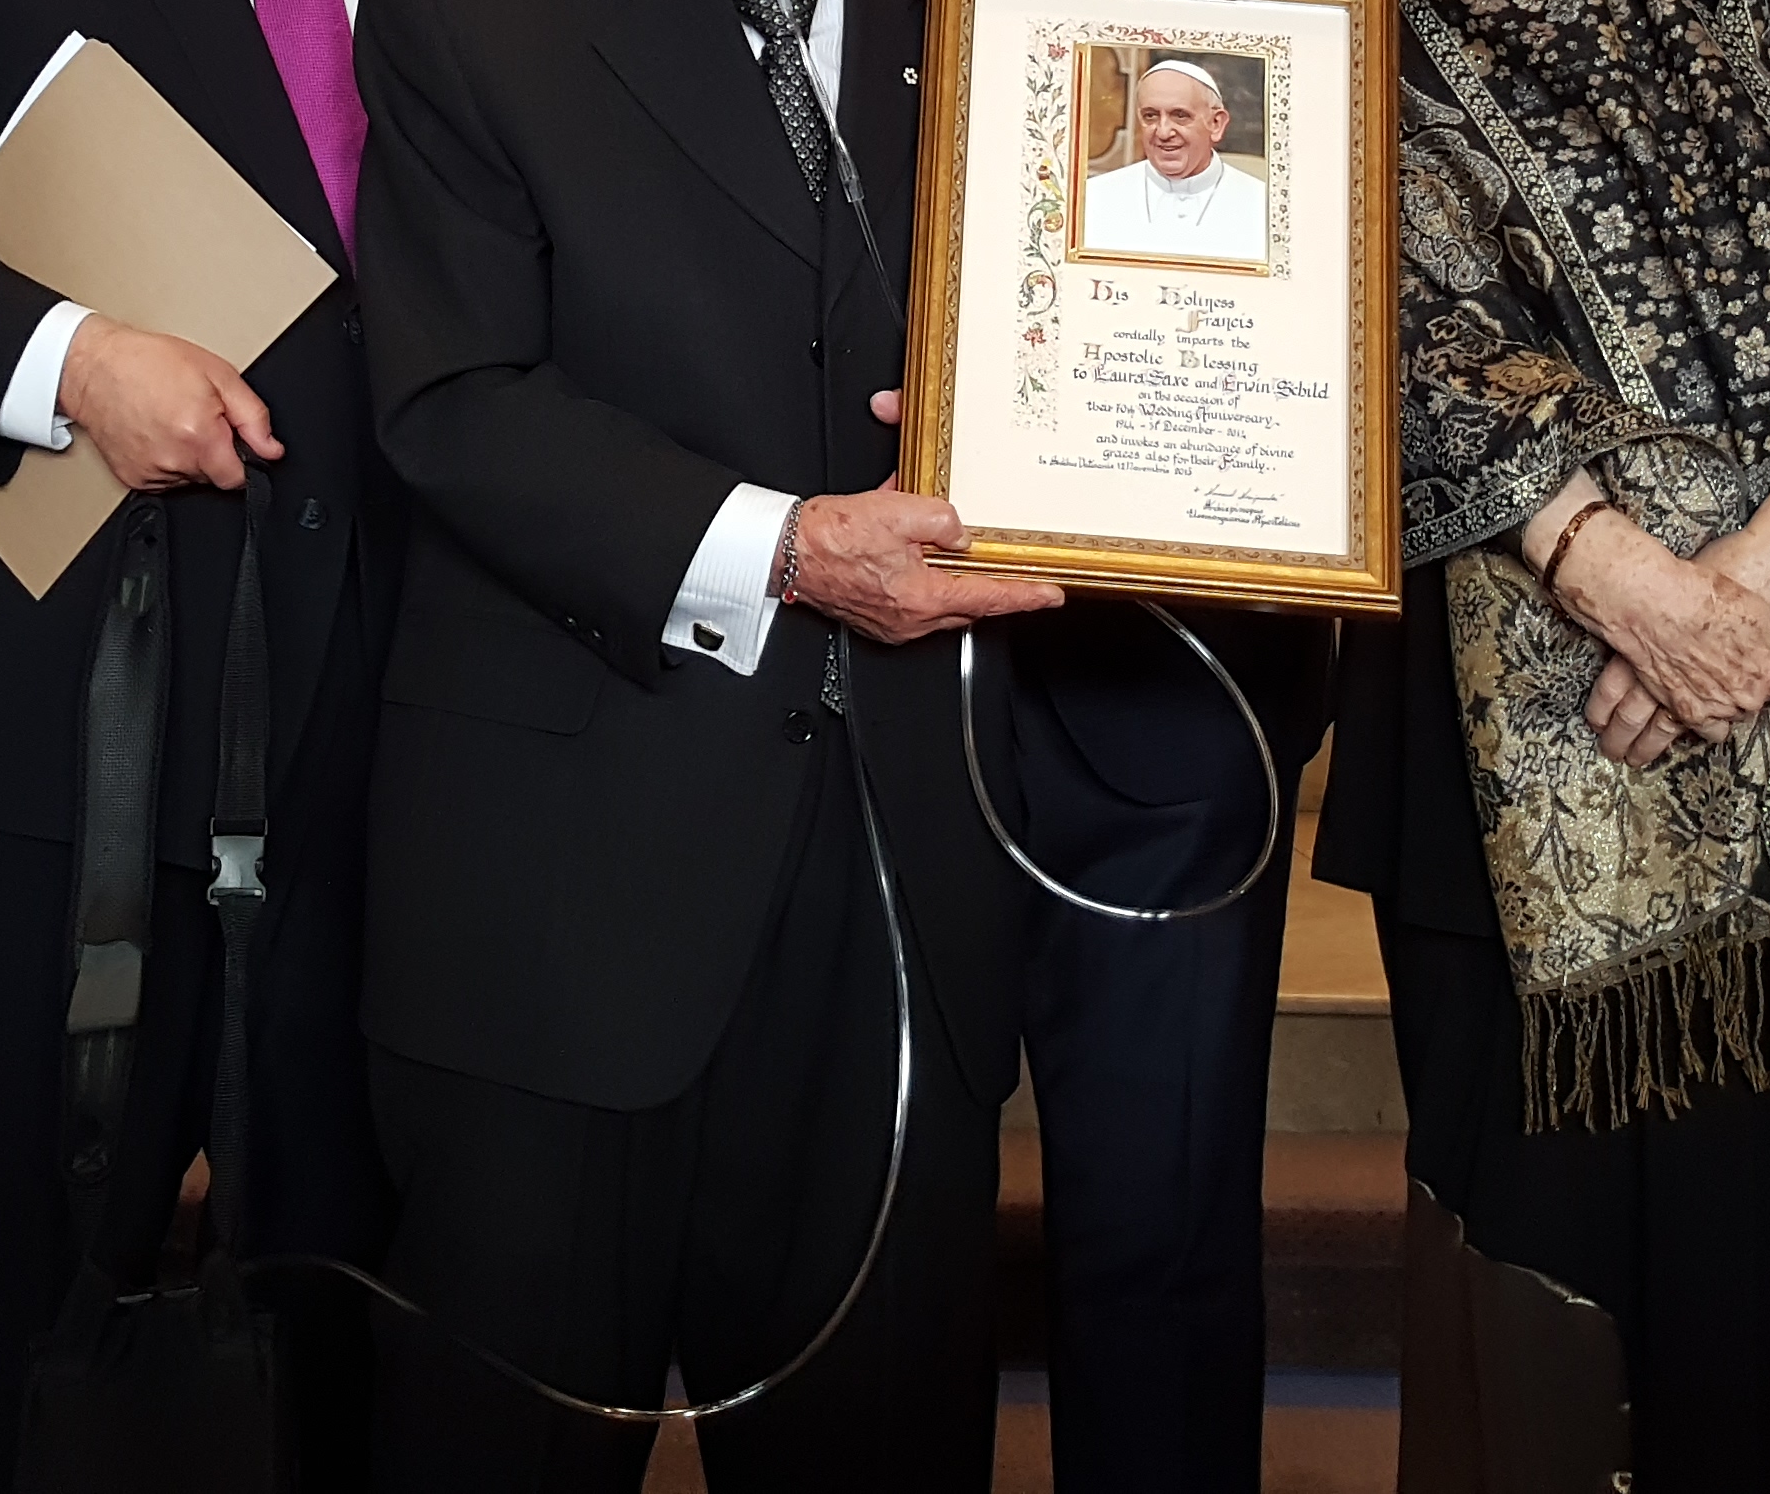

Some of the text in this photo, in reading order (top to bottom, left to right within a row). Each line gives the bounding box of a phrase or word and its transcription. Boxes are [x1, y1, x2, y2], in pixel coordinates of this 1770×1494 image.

[1091, 279, 1235, 312] His Holiness
[1175, 310, 1254, 333] Francis
[1113, 329, 1250, 349] cordially imparts the
[1083, 342, 1259, 376] Apostolic Blessing
[1073, 364, 1329, 400] to Laura Saxe and Erwin Schild
[1138, 391, 1240, 409] on the occasion of
[1086, 401, 1113, 412] their
[1139, 403, 1193, 423] Wedding
[1163, 420, 1215, 435] December
[1096, 434, 1118, 444] and
[1121, 436, 1159, 448] invokes
[1180, 439, 1241, 455] abundance
[1245, 443, 1259, 457] of
[1259, 446, 1295, 458] divine
[1102, 449, 1140, 461] graces
[1145, 451, 1170, 462] also
[1173, 453, 1189, 465] for
[1191, 454, 1216, 466] their
